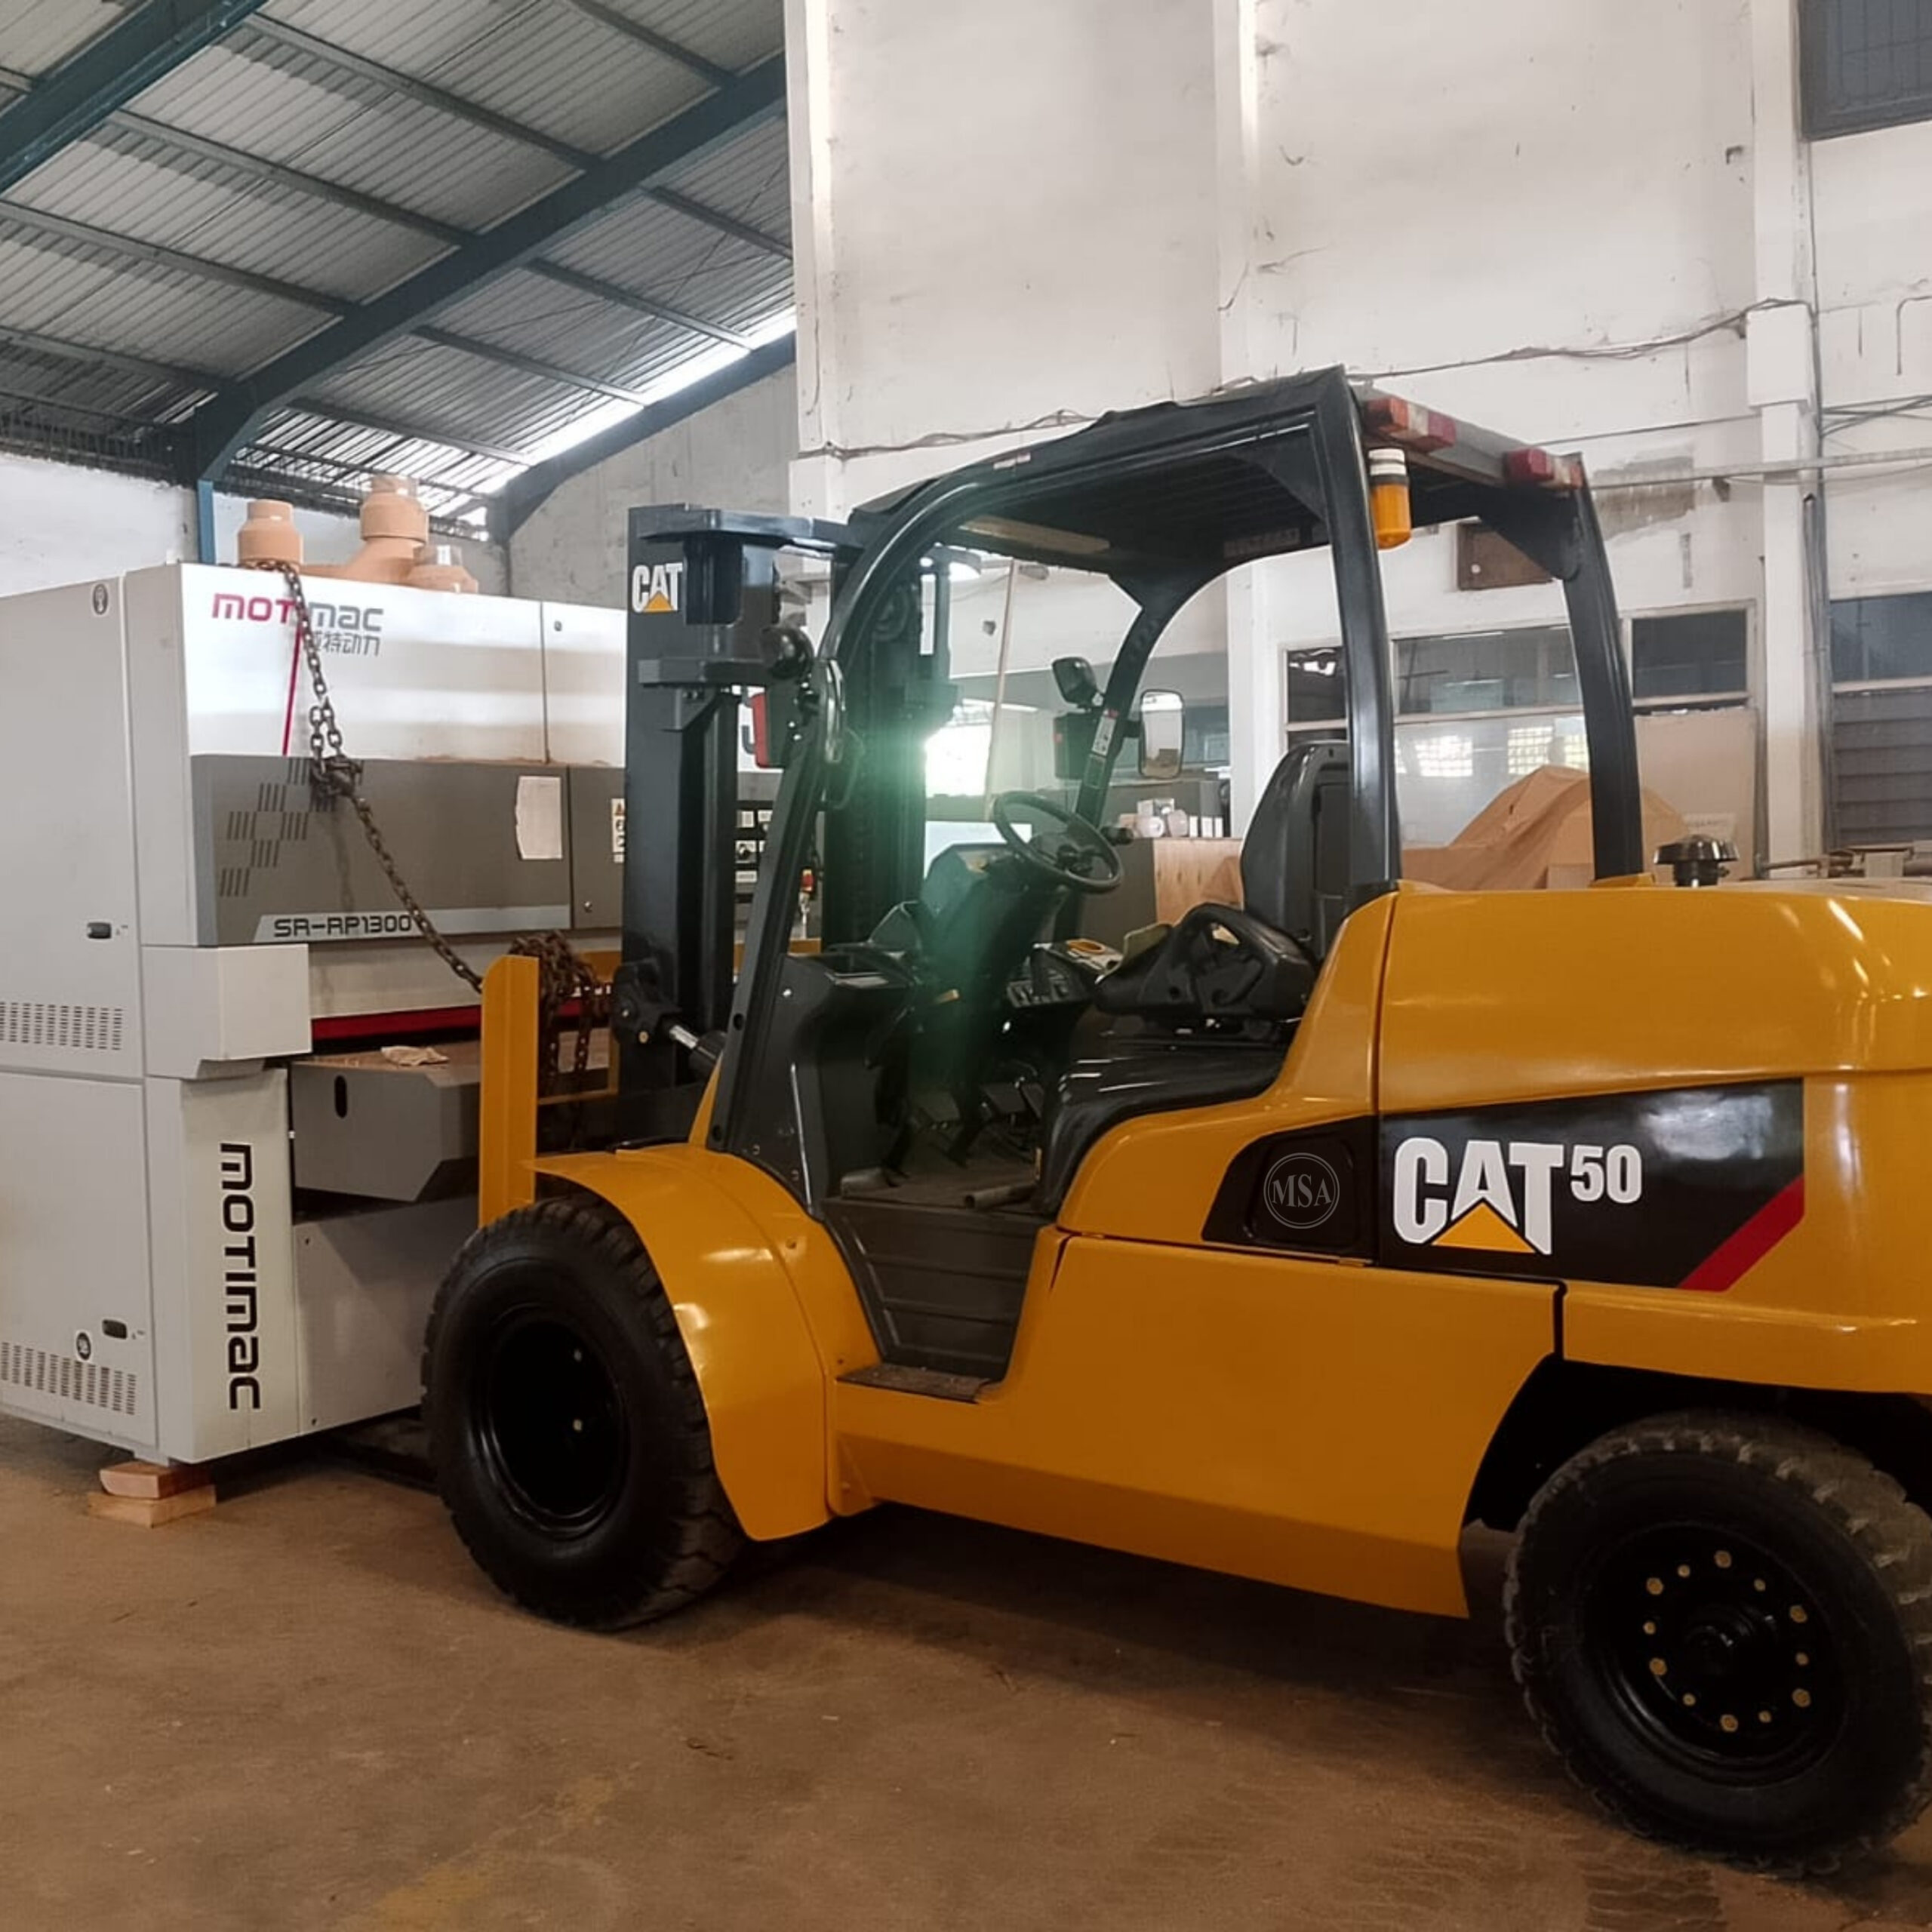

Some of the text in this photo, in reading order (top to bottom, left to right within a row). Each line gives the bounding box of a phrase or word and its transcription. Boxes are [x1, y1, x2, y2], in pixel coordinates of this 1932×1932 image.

[212, 593, 383, 632] MOTMAC
[632, 562, 683, 613] CAT
[1393, 1137, 1642, 1255] CAT 50
